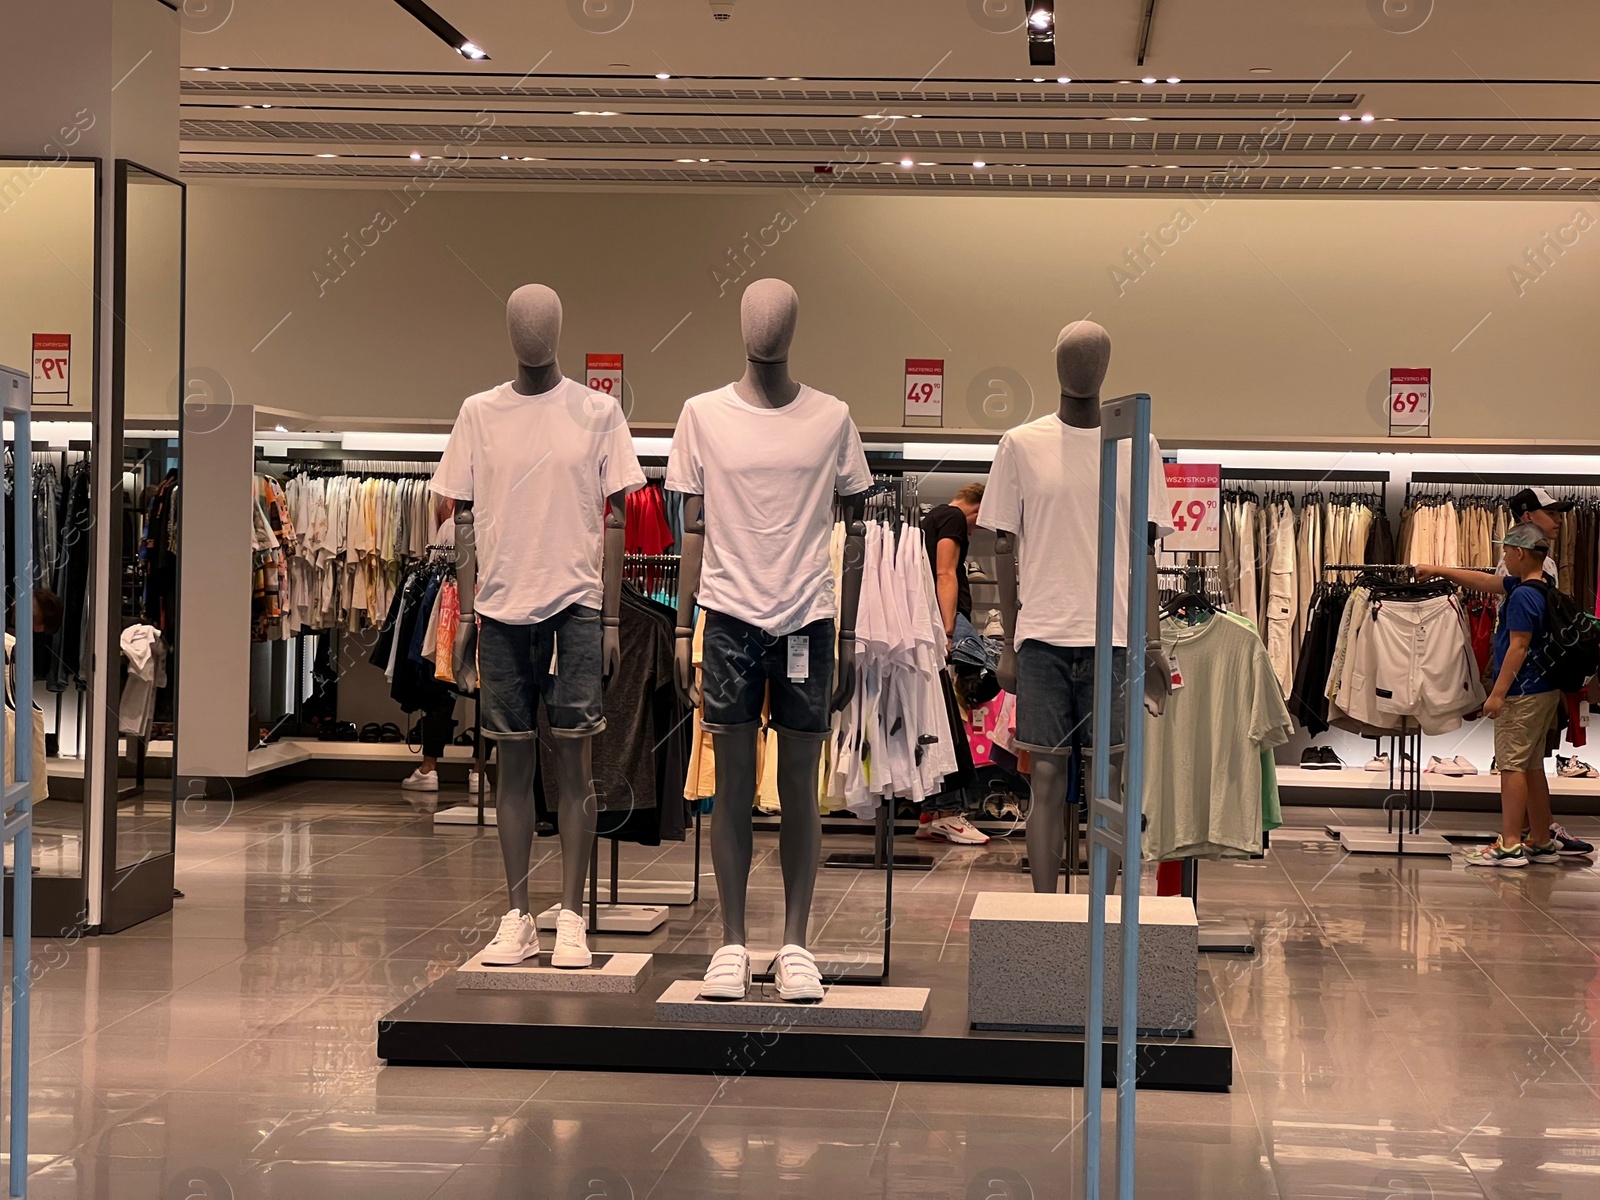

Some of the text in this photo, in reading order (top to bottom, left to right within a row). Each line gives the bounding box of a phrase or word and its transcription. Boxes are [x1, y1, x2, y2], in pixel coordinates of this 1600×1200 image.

[907, 382, 933, 403] 49
[1393, 392, 1419, 413] 69
[1166, 476, 1218, 484] WSZYSTKO PO
[1171, 500, 1217, 531] 49 90
